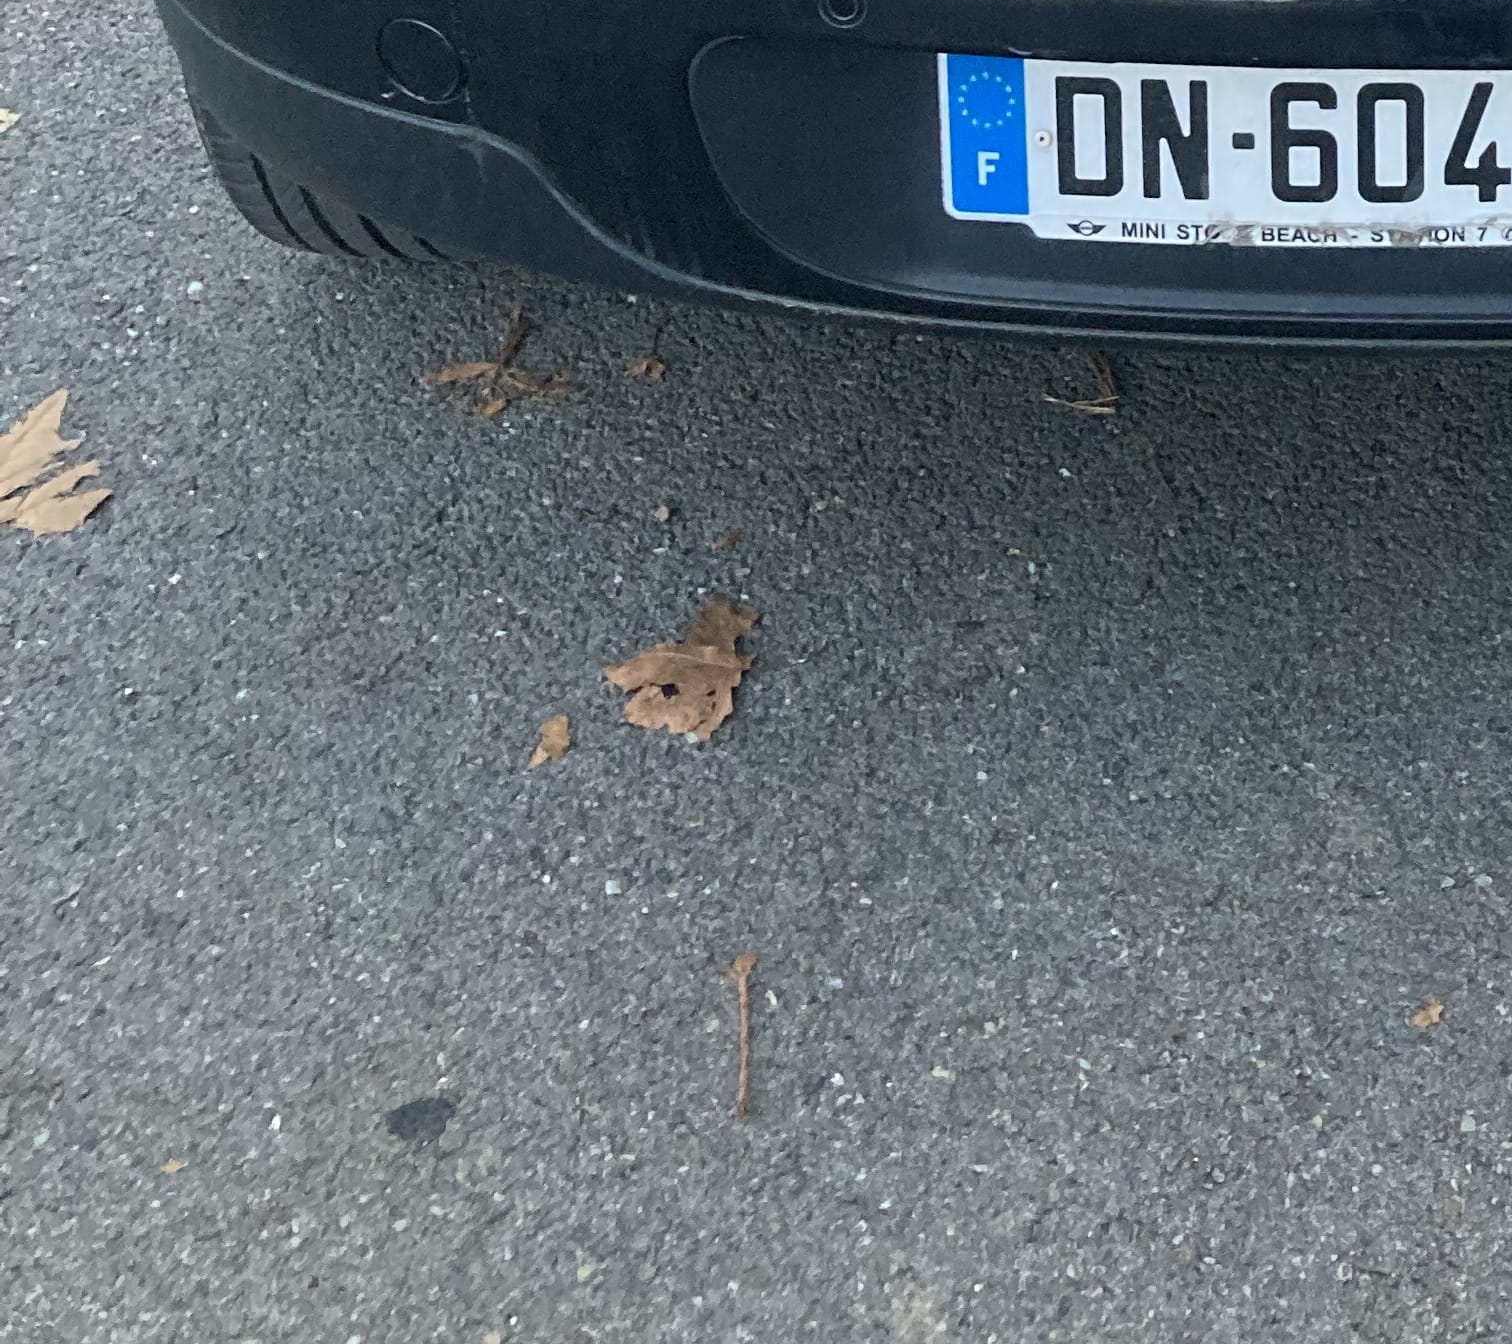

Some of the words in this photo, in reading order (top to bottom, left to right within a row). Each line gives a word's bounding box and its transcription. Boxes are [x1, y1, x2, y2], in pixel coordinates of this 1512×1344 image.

[977, 152, 1000, 186] F
[1122, 222, 1166, 239] MINI
[1262, 226, 1336, 243] BEACH
[1477, 226, 1488, 240] 7
